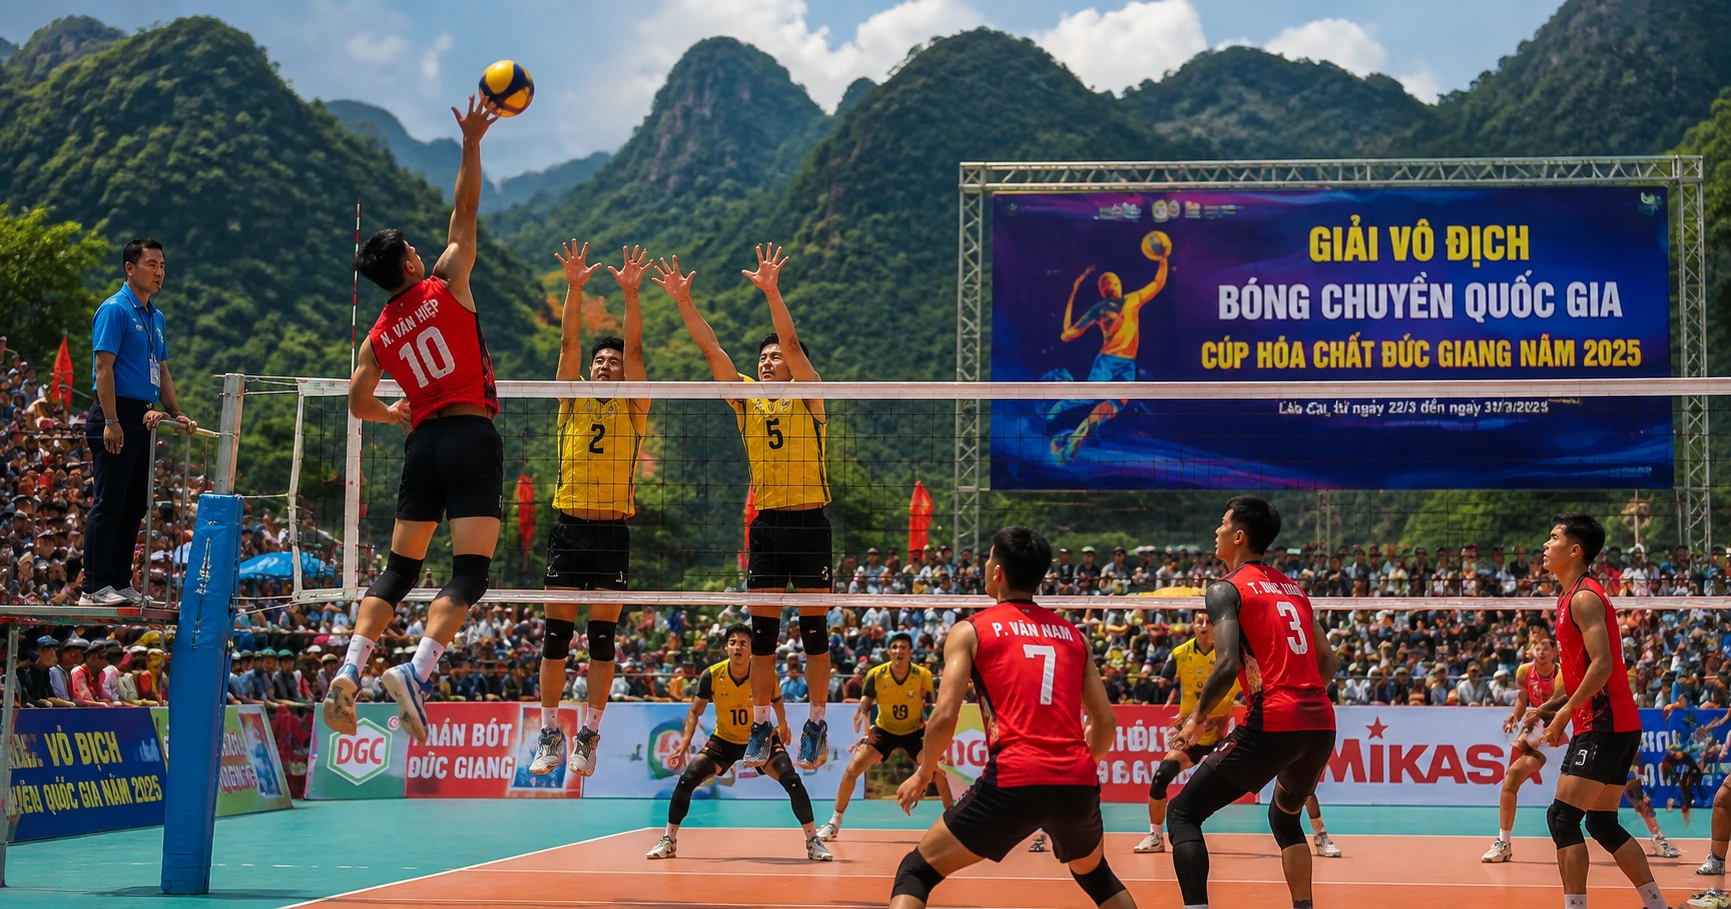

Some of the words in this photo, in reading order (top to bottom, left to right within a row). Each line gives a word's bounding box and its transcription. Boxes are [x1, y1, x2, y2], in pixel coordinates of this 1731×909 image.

[1309, 214, 1378, 262] GIẢI
[1389, 218, 1434, 262] VÔ
[1446, 225, 1530, 268] ĐỊCH
[1218, 277, 1310, 320] BÓNG
[1321, 271, 1453, 320] CHUYỀN
[1465, 269, 1555, 323] QUỐC
[1566, 281, 1623, 318] GIA
[398, 325, 456, 389] 10
[1201, 335, 1250, 369] CÚP
[1257, 335, 1307, 368] HÓA
[1313, 331, 1375, 368] CHẤT
[1381, 333, 1430, 369] ĐỨC
[1437, 340, 1512, 368] GIANG
[1583, 339, 1642, 367] 2025
[588, 423, 606, 455] 2
[765, 418, 784, 450] 5
[991, 622, 1009, 638] P.
[1040, 623, 1074, 642] NAM
[1276, 601, 1308, 655] 3
[1022, 643, 1057, 706] 7
[729, 708, 749, 726] 10
[336, 736, 385, 765] DGC
[454, 756, 513, 779] GIANG
[78, 780, 103, 809] GIA
[130, 774, 163, 804] 2025
